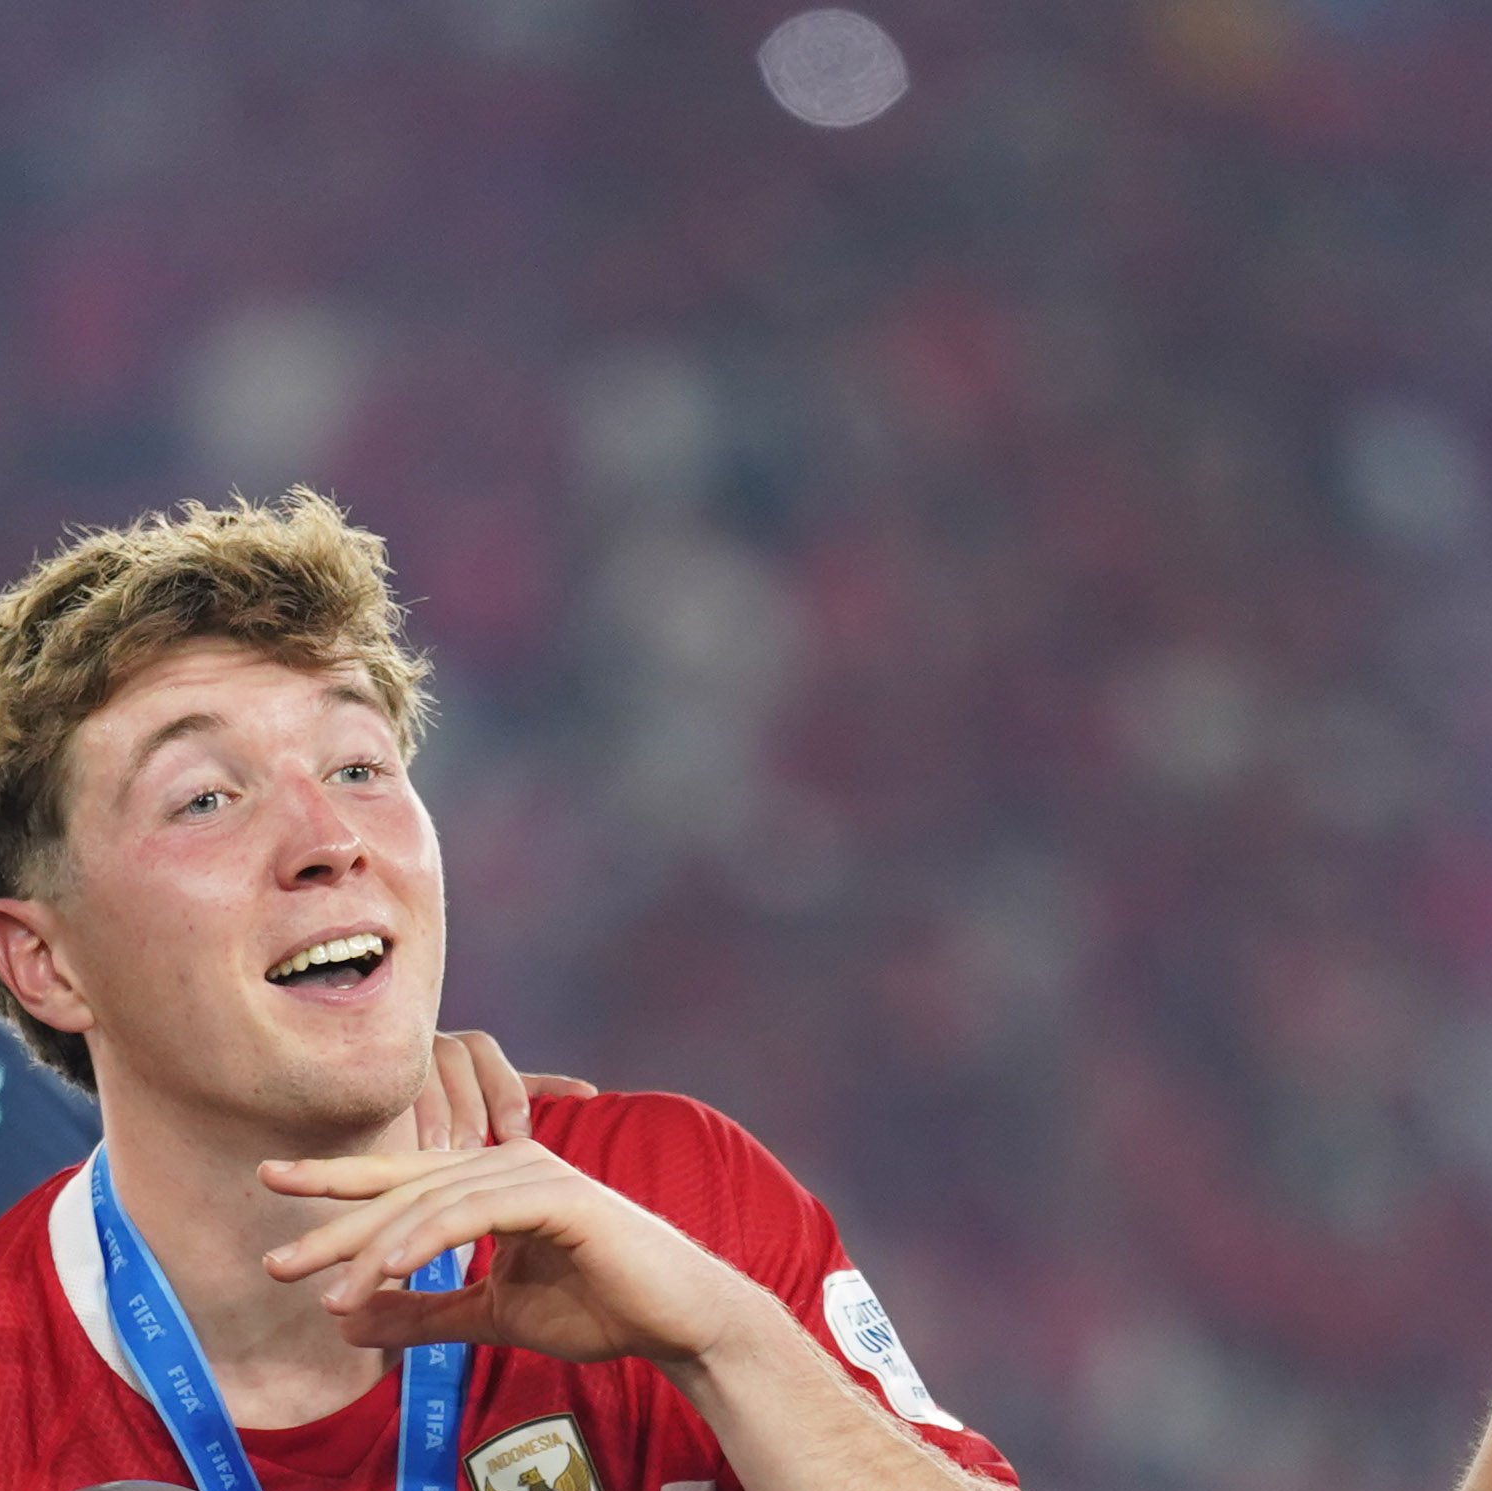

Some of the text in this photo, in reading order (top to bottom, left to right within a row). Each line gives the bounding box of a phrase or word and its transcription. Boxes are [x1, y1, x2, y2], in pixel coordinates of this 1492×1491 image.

[128, 1293, 164, 1343] FIFA
[167, 1364, 203, 1416] FIFA
[425, 1399, 446, 1451] FIFA
[206, 1441, 237, 1491] FIFA
[486, 1432, 564, 1475] INDONESIA
